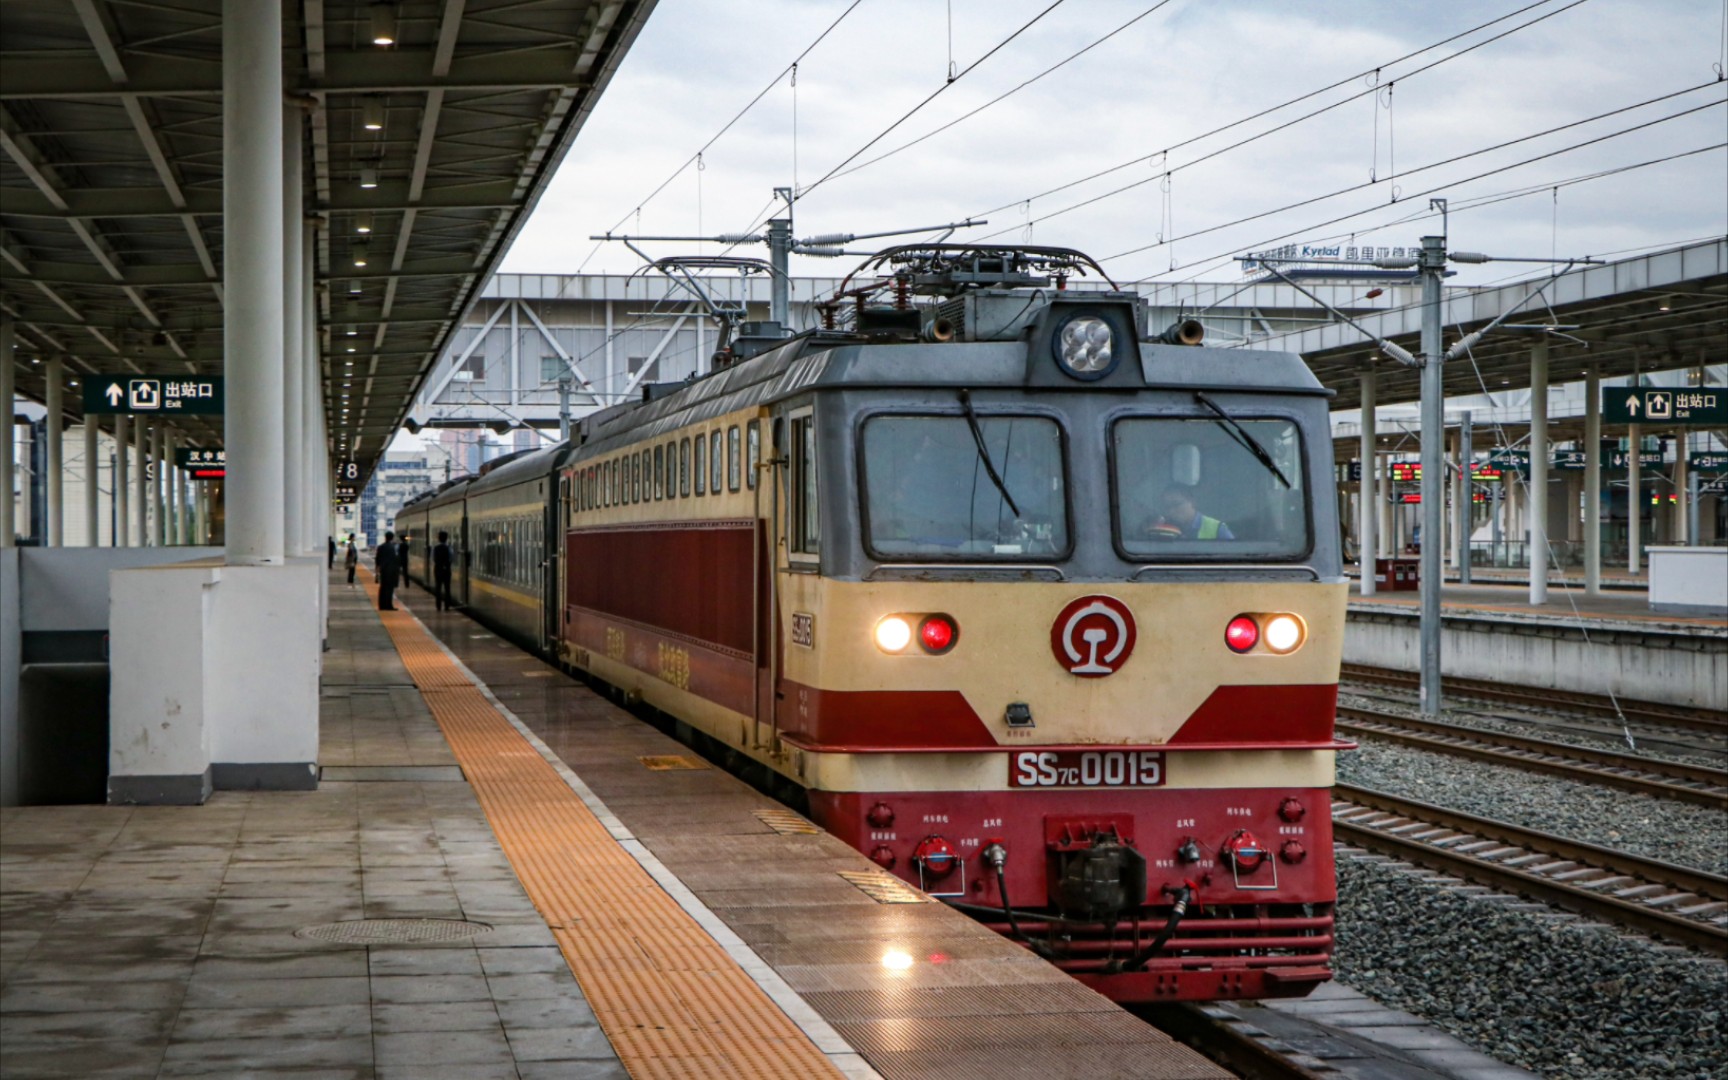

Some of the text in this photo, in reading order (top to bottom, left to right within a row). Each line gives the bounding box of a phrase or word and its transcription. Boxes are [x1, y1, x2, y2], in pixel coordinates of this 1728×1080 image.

[1302, 245, 1340, 259] Kyriad
[165, 381, 213, 398] 出站口
[165, 399, 182, 408] Exit
[1676, 393, 1716, 408] 出站口
[1676, 410, 1690, 418] Exit
[346, 463, 358, 479] 8
[1017, 752, 1160, 786] SS7C0015
